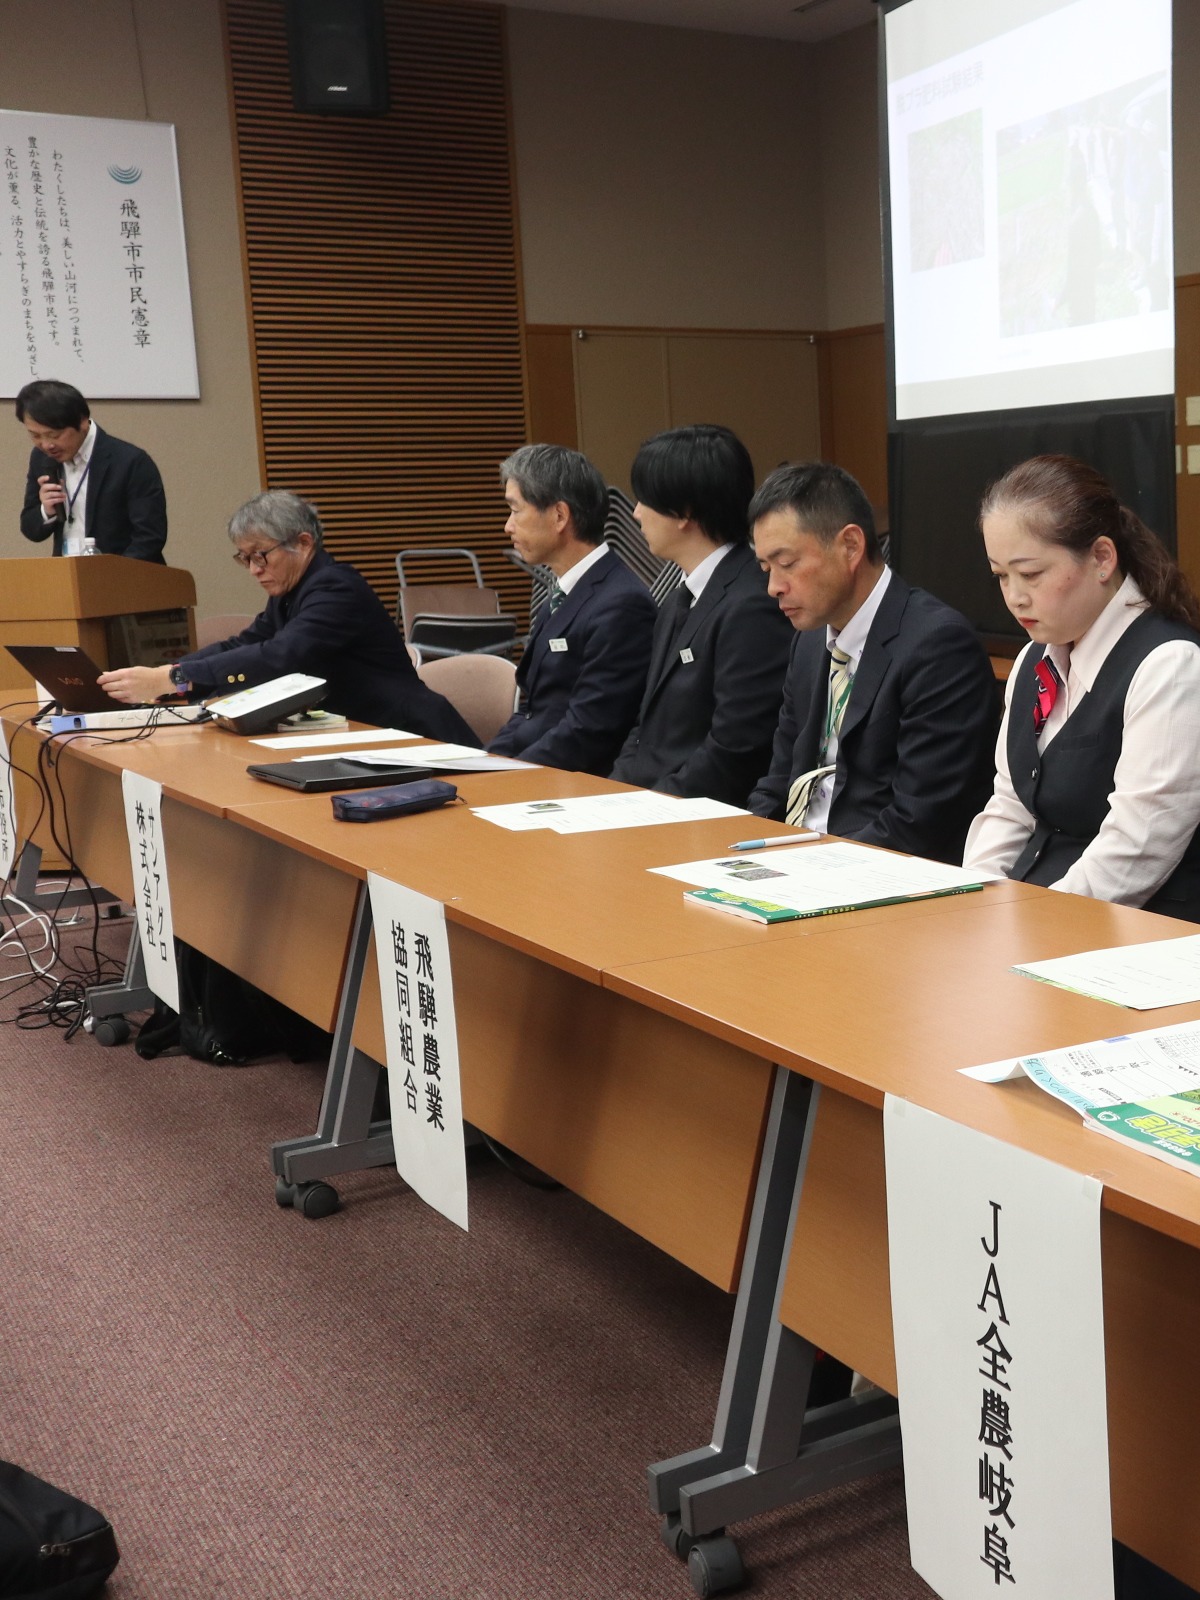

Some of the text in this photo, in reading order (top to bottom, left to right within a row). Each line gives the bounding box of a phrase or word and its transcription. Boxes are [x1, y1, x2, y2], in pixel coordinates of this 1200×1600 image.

[119, 198, 151, 348] 飛騨市市民憲章
[135, 800, 157, 947] 株式会社
[148, 808, 168, 962] サンアグロ
[391, 919, 418, 1115] 協同組合
[414, 931, 446, 1132] 飛騨農業
[976, 1199, 1017, 1587] JA全農岐阜
